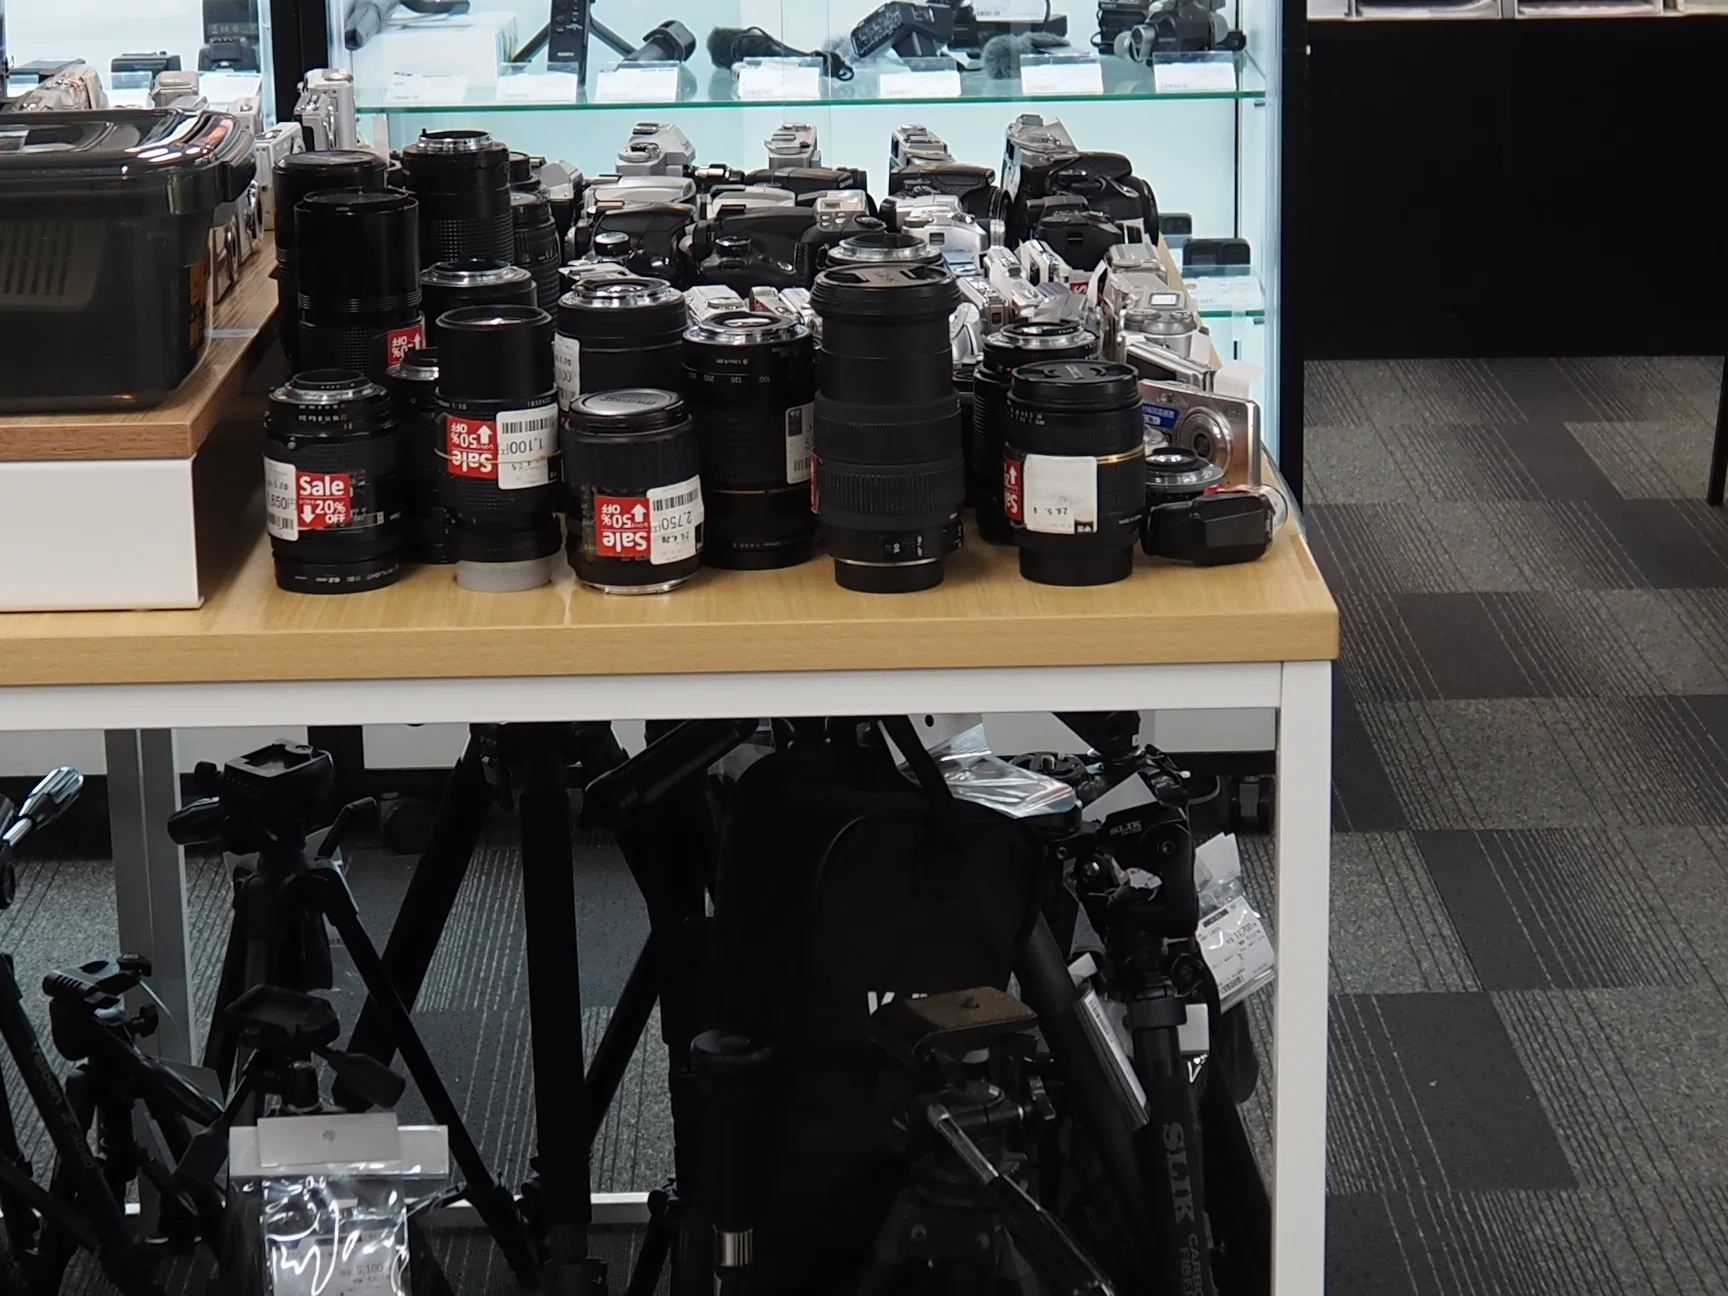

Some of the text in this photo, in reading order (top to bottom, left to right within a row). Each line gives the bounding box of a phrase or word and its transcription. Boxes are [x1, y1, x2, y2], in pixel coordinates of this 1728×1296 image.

[450, 421, 468, 433] OFF
[450, 432, 478, 449] 50%
[451, 450, 493, 473] Sale
[299, 475, 346, 497] Sale
[315, 499, 346, 515] 20%
[601, 502, 621, 515] OFF
[325, 514, 346, 524] OFF
[601, 513, 632, 529] 50%
[601, 531, 648, 553] Sale
[1162, 1122, 1196, 1224] SLIK
